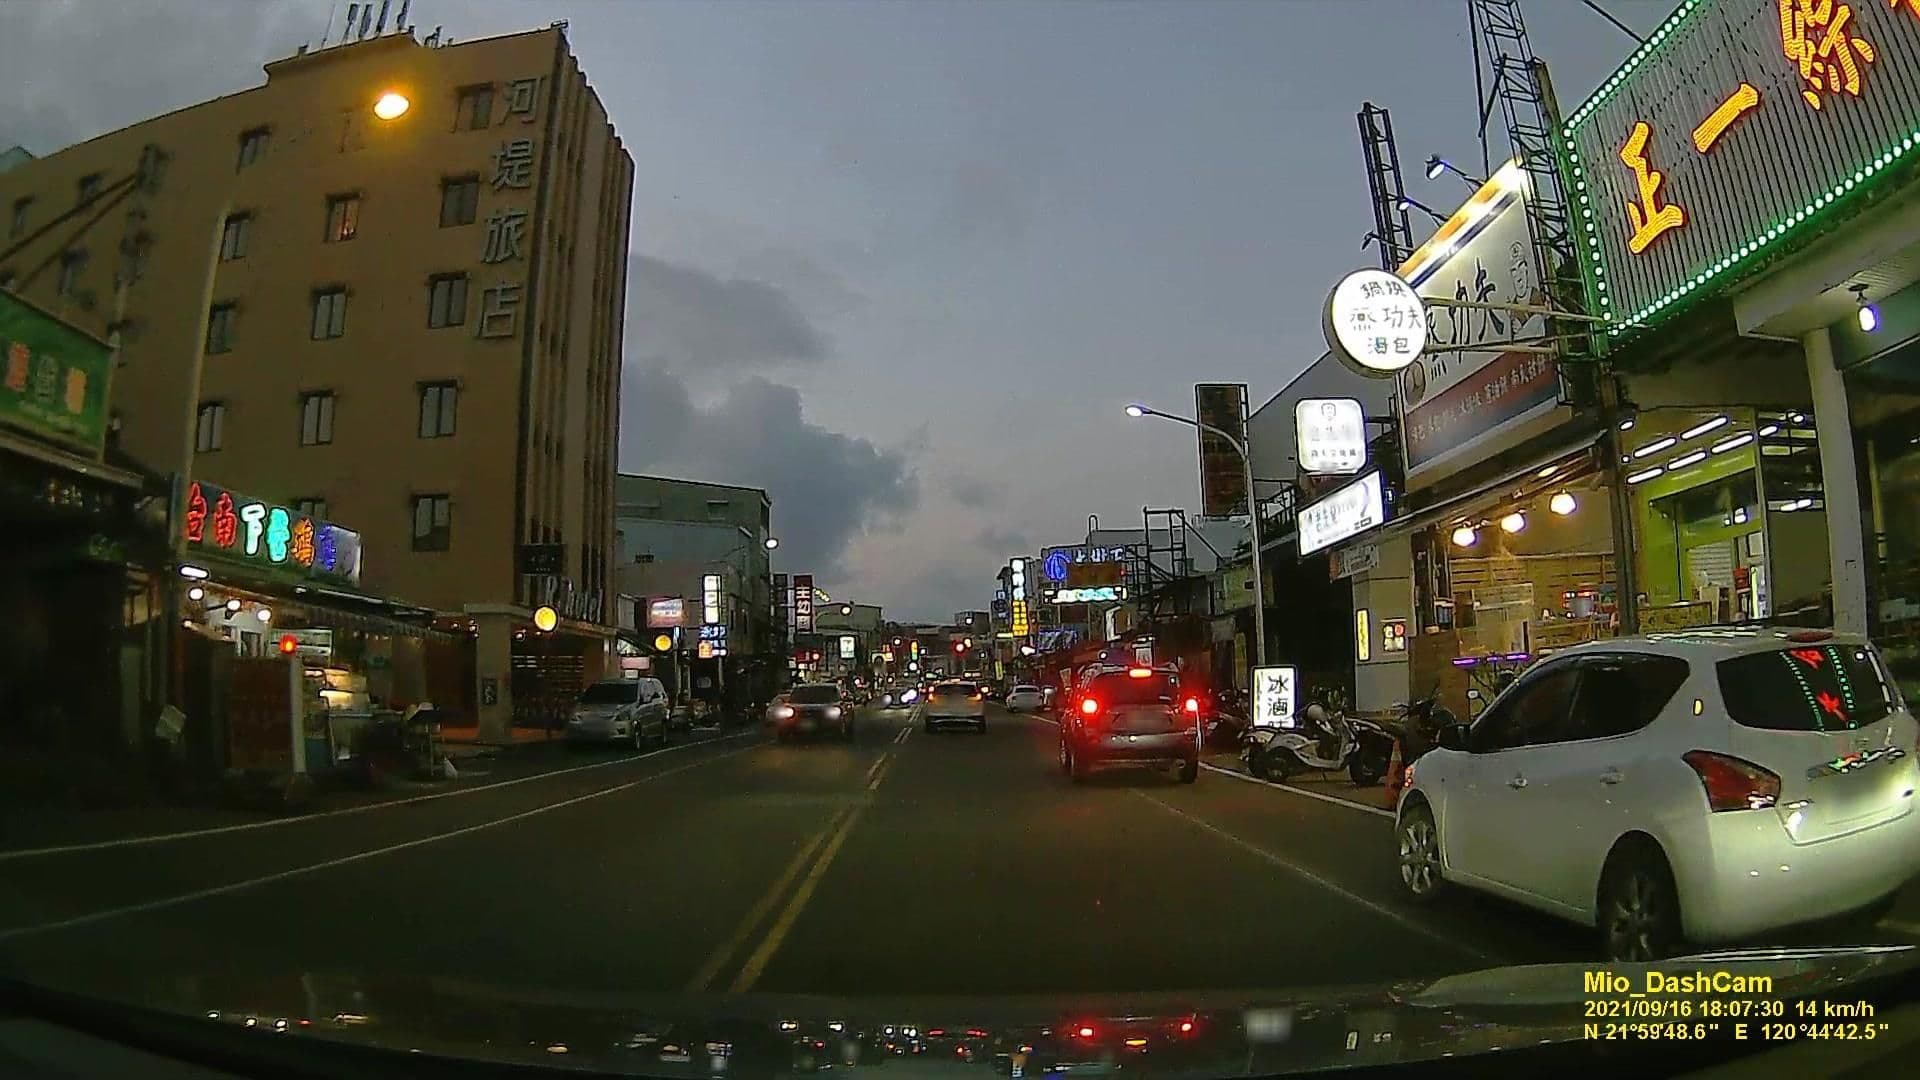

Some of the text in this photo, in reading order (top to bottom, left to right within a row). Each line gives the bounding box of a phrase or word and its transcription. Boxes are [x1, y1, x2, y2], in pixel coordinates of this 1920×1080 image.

[475, 75, 546, 340] 河堤旅店
[1618, 0, 1920, 255] 正一綠
